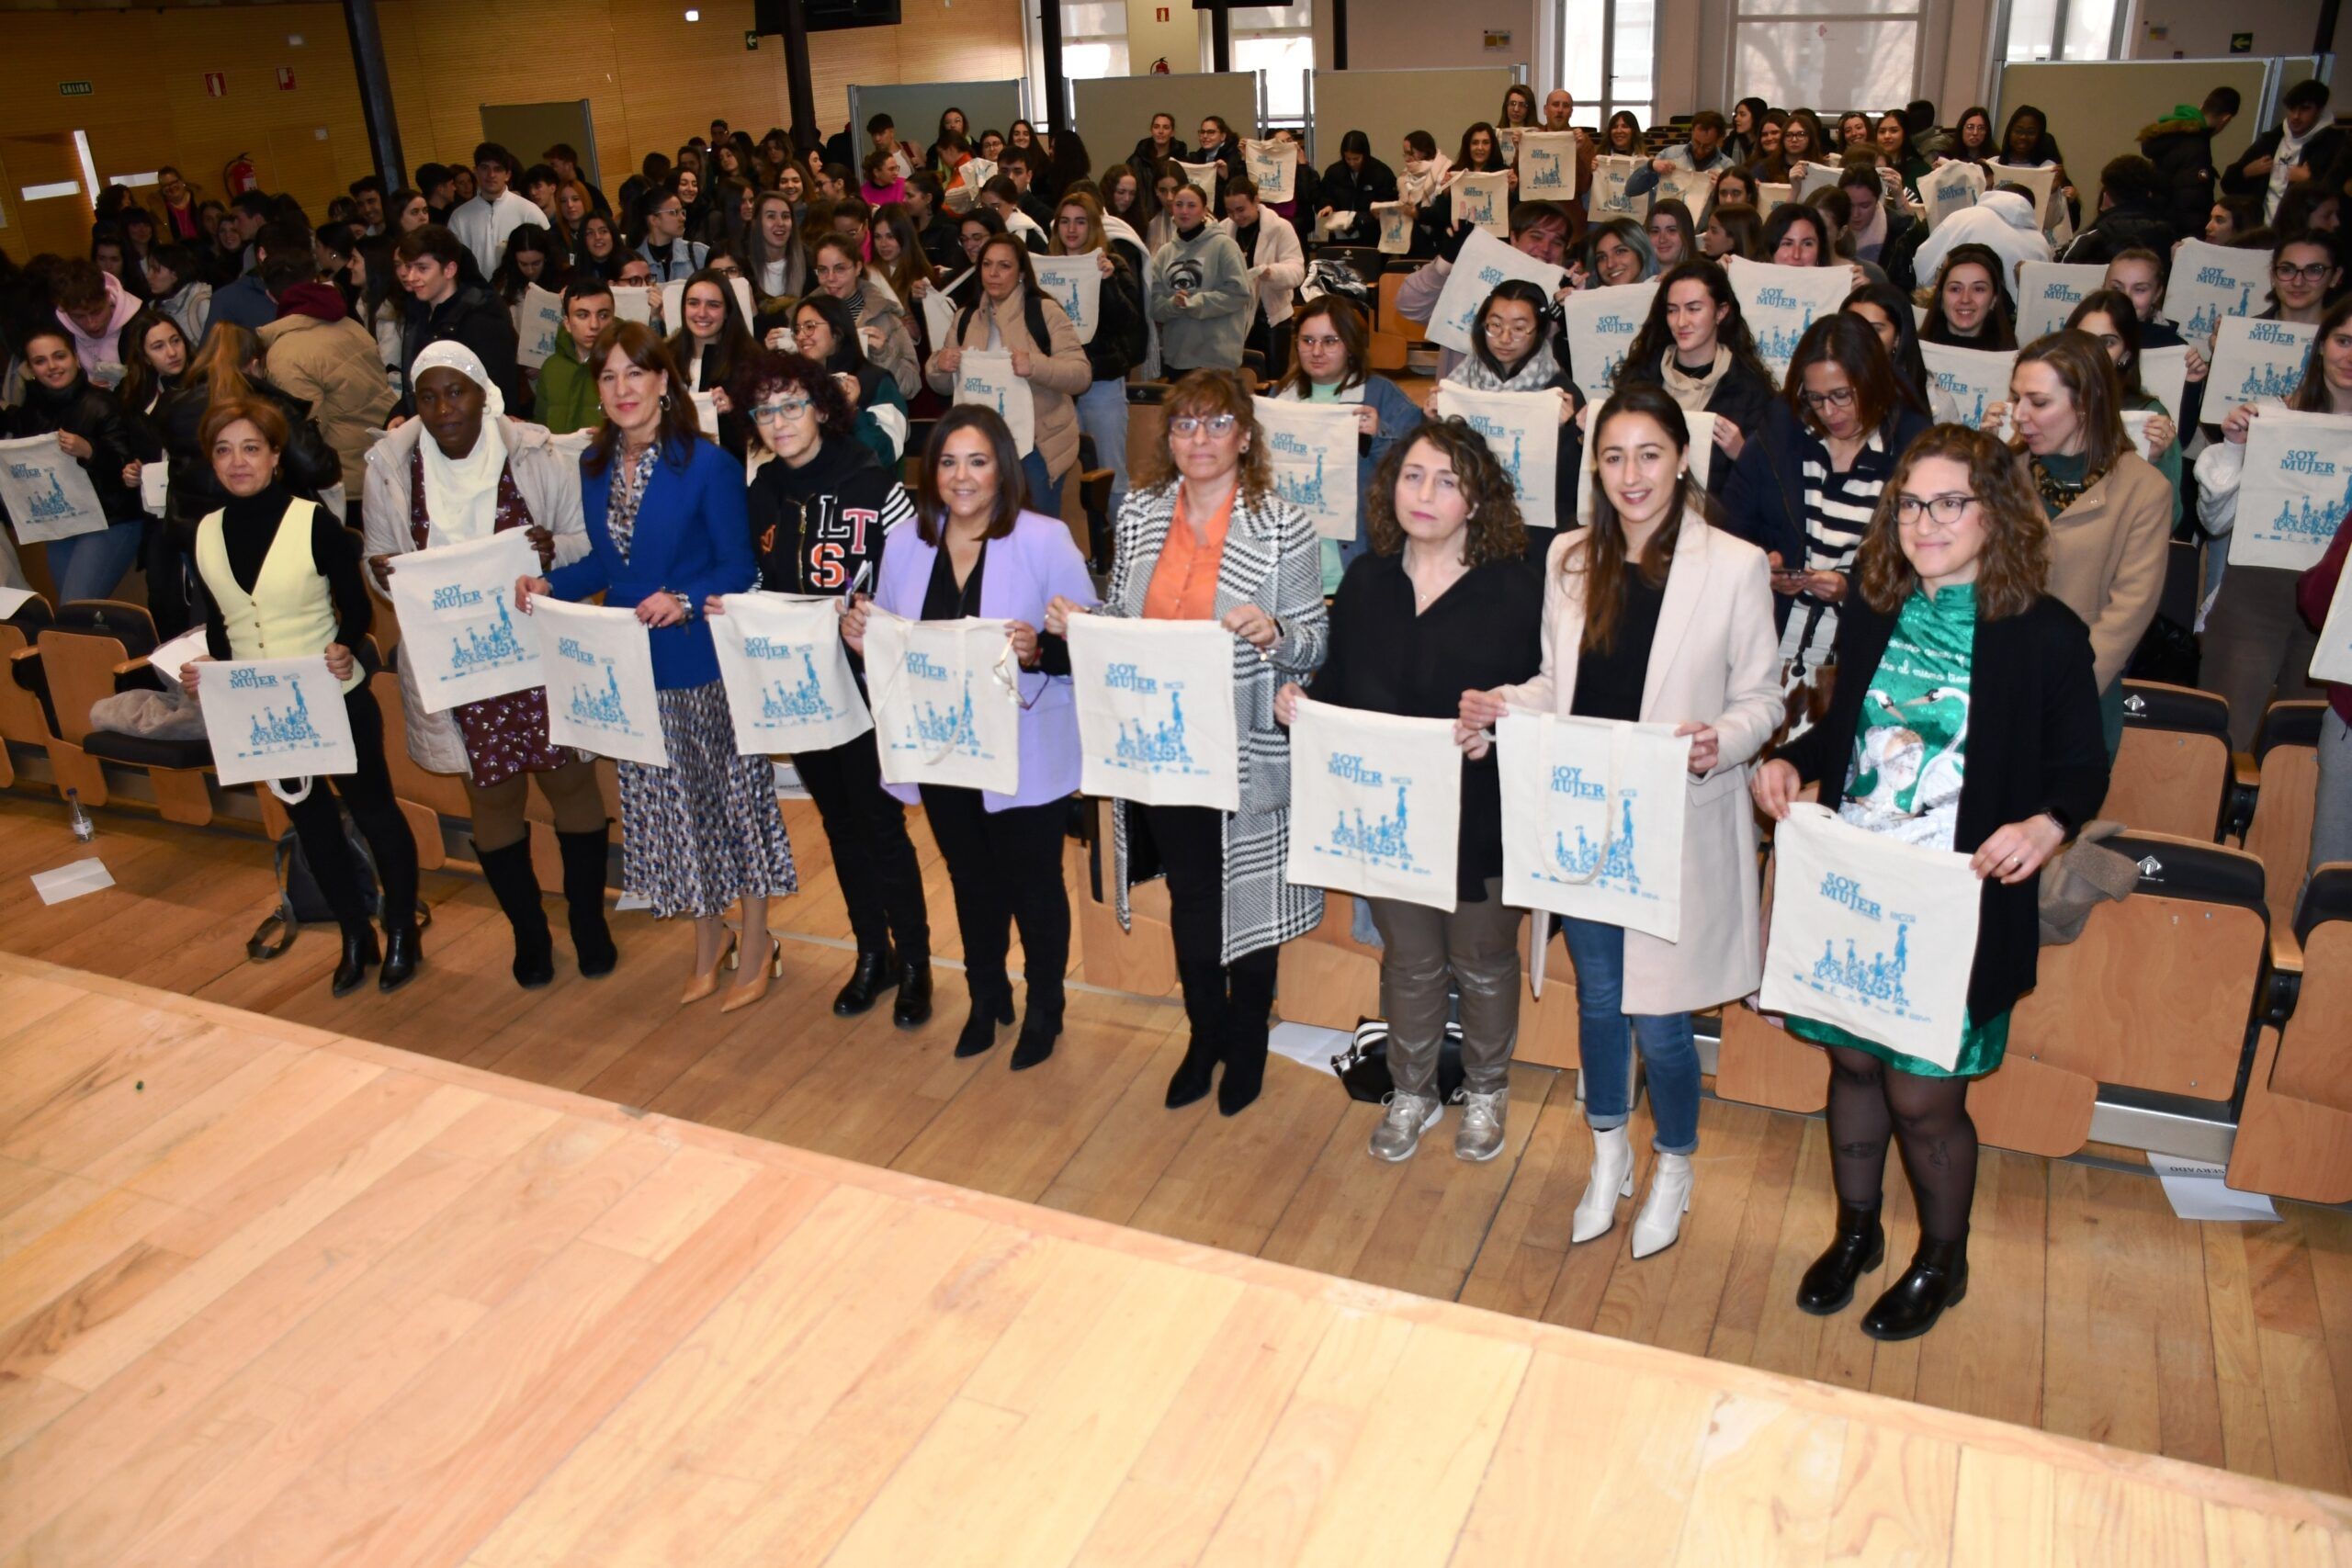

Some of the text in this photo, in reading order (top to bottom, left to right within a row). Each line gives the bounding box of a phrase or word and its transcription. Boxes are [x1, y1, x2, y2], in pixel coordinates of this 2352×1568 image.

[61, 84, 91, 94] SALIDA
[1486, 265, 1504, 281] SOY
[2202, 266, 2224, 276] SOY
[2196, 274, 2236, 288] MUJER
[1760, 288, 1784, 297] SOY
[2048, 284, 2070, 292] SOY
[1756, 295, 1797, 309] MUJER
[2043, 290, 2082, 301] MUJER
[1595, 321, 1634, 333] MUJER
[2255, 323, 2281, 333] SOY
[2248, 331, 2295, 344] MUJER
[1274, 432, 1295, 442] SOY
[1272, 439, 1307, 453] MUJER
[2288, 450, 2319, 460] SOY
[2280, 459, 2335, 474] MUJER
[434, 584, 461, 599] SOY
[432, 591, 483, 611] MUJER
[559, 637, 579, 649] SOY
[744, 637, 770, 647] SOY
[558, 644, 595, 662] MUJER
[744, 646, 790, 660] MUJER
[231, 668, 256, 680] SOY
[1108, 663, 1137, 675] SOY
[230, 675, 278, 688] MUJER
[1105, 673, 1157, 691] MUJER
[1331, 751, 1363, 765] SOY
[1328, 761, 1383, 783] MUJER
[1826, 872, 1860, 894] SOY
[1819, 882, 1882, 918] MUJER
